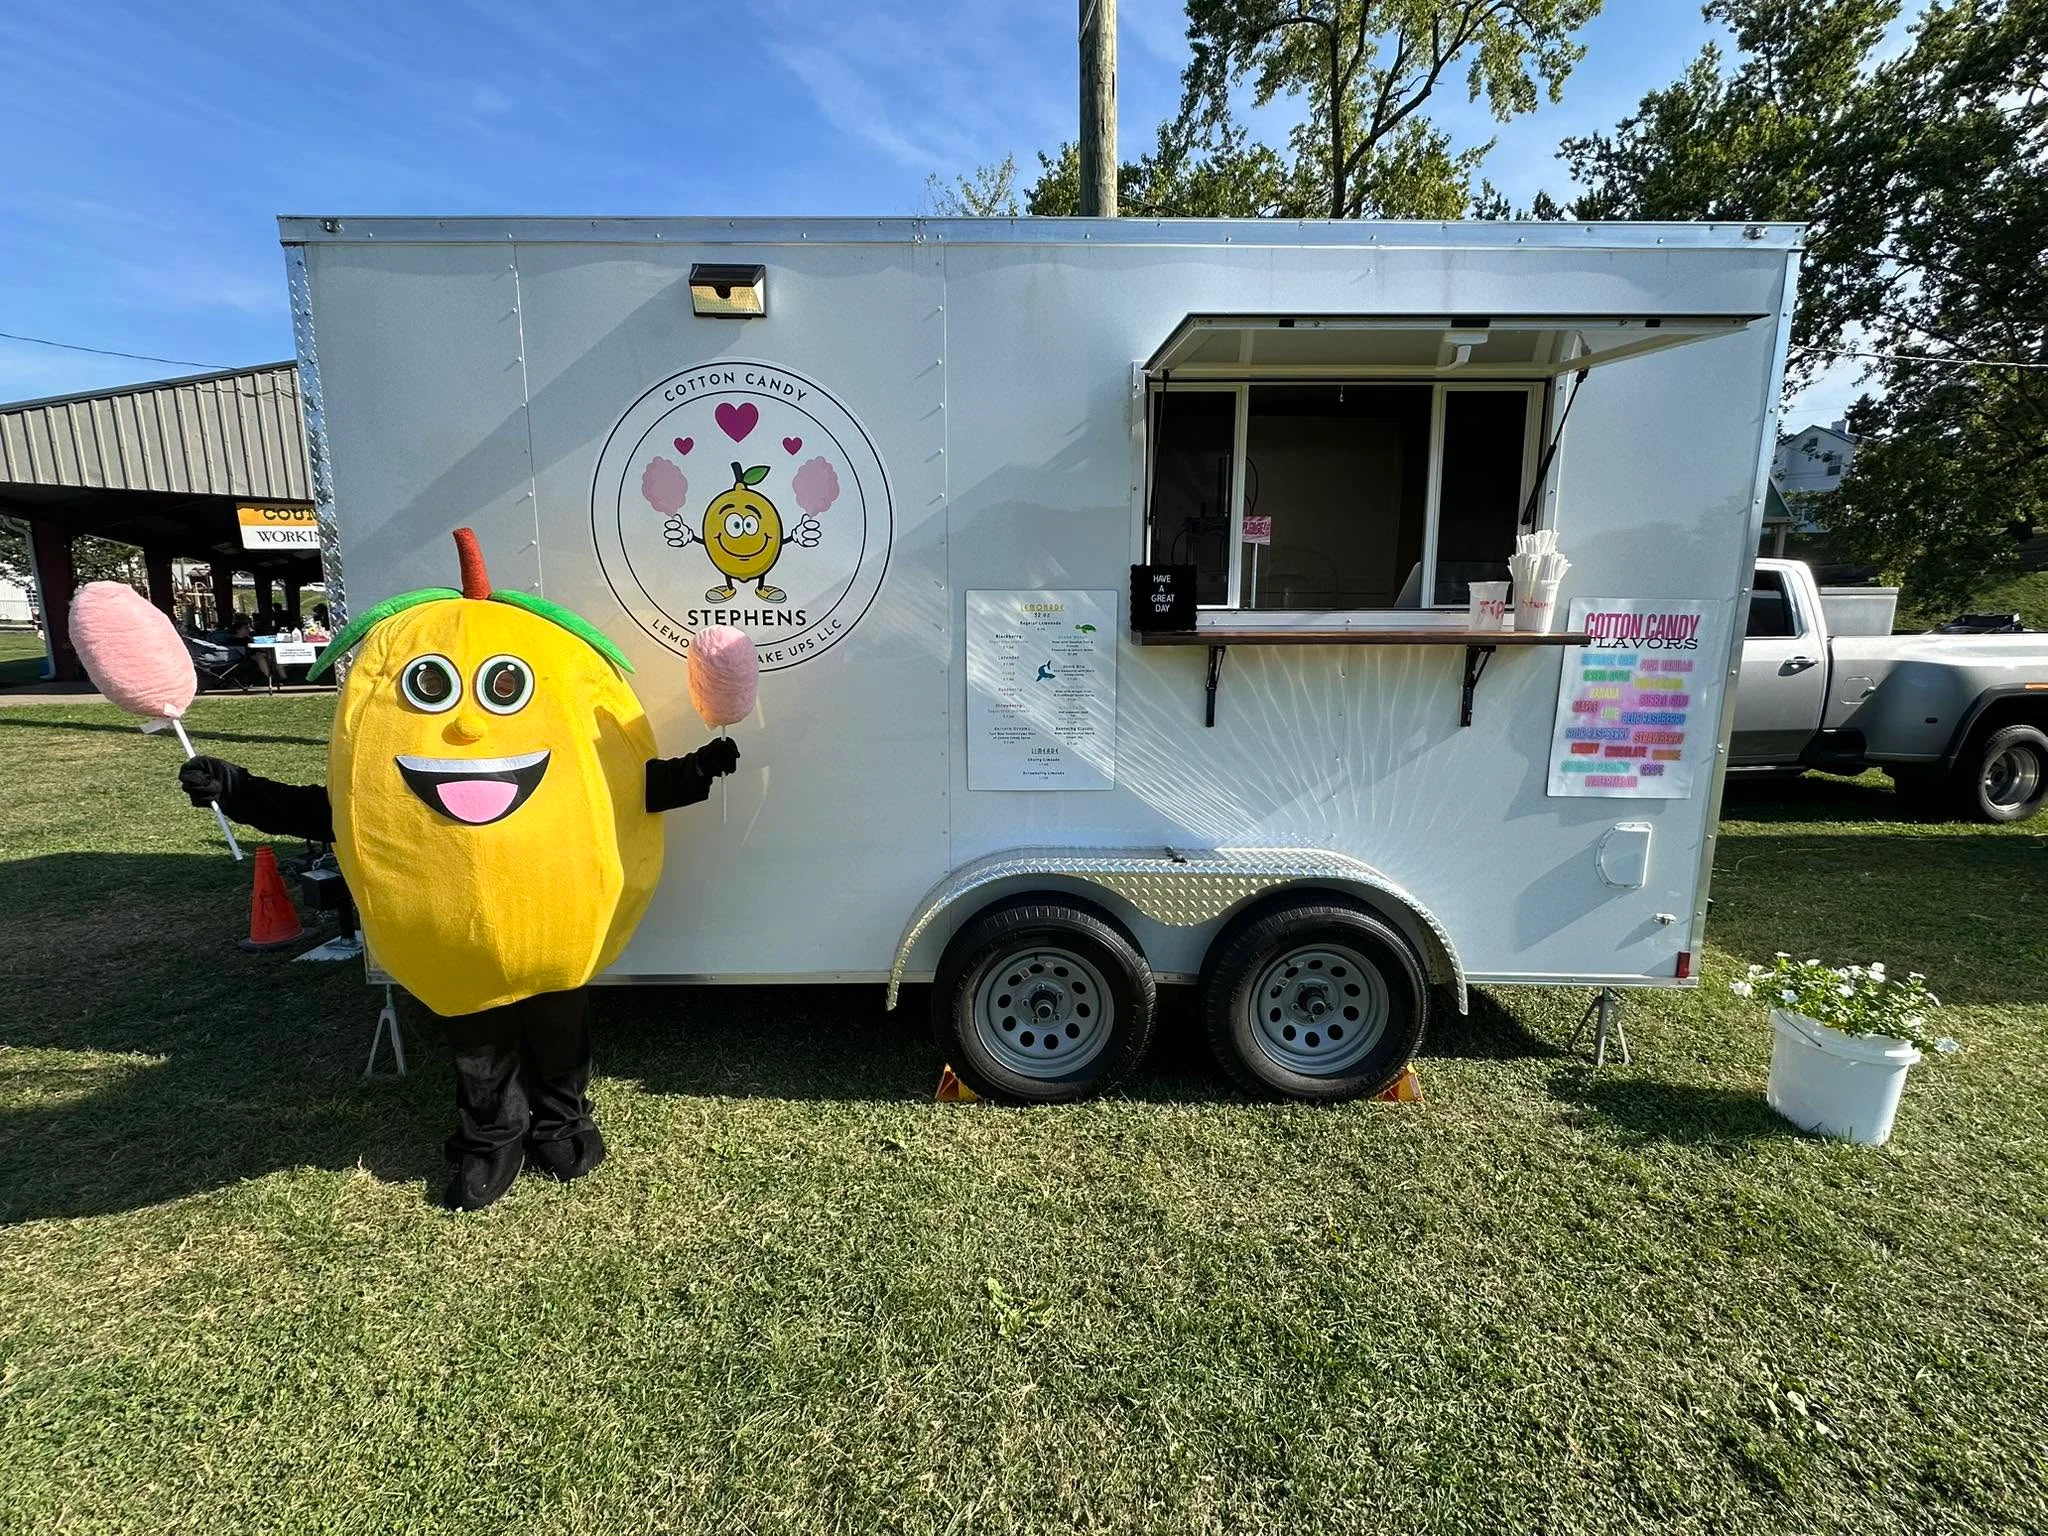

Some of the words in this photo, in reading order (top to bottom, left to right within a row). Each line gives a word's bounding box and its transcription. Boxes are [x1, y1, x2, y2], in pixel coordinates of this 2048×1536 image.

[664, 371, 735, 402] COTTON
[745, 372, 807, 402] CANDY
[1153, 574, 1171, 583] HAVE
[1158, 584, 1165, 593] A
[1151, 594, 1175, 603] GREAT
[1155, 604, 1170, 613] DAY
[687, 609, 806, 626] STEPHENS
[1584, 612, 1643, 639] COTTON
[1645, 613, 1701, 640] CANDY
[652, 618, 690, 649] LEMO
[757, 651, 784, 665] AKE
[788, 639, 815, 658] UPS
[817, 619, 842, 642] LLC
[1642, 712, 1687, 726] RASPBERRY
[1587, 727, 1631, 740] RASPBERRY
[1632, 731, 1685, 745] STRAWBERRY
